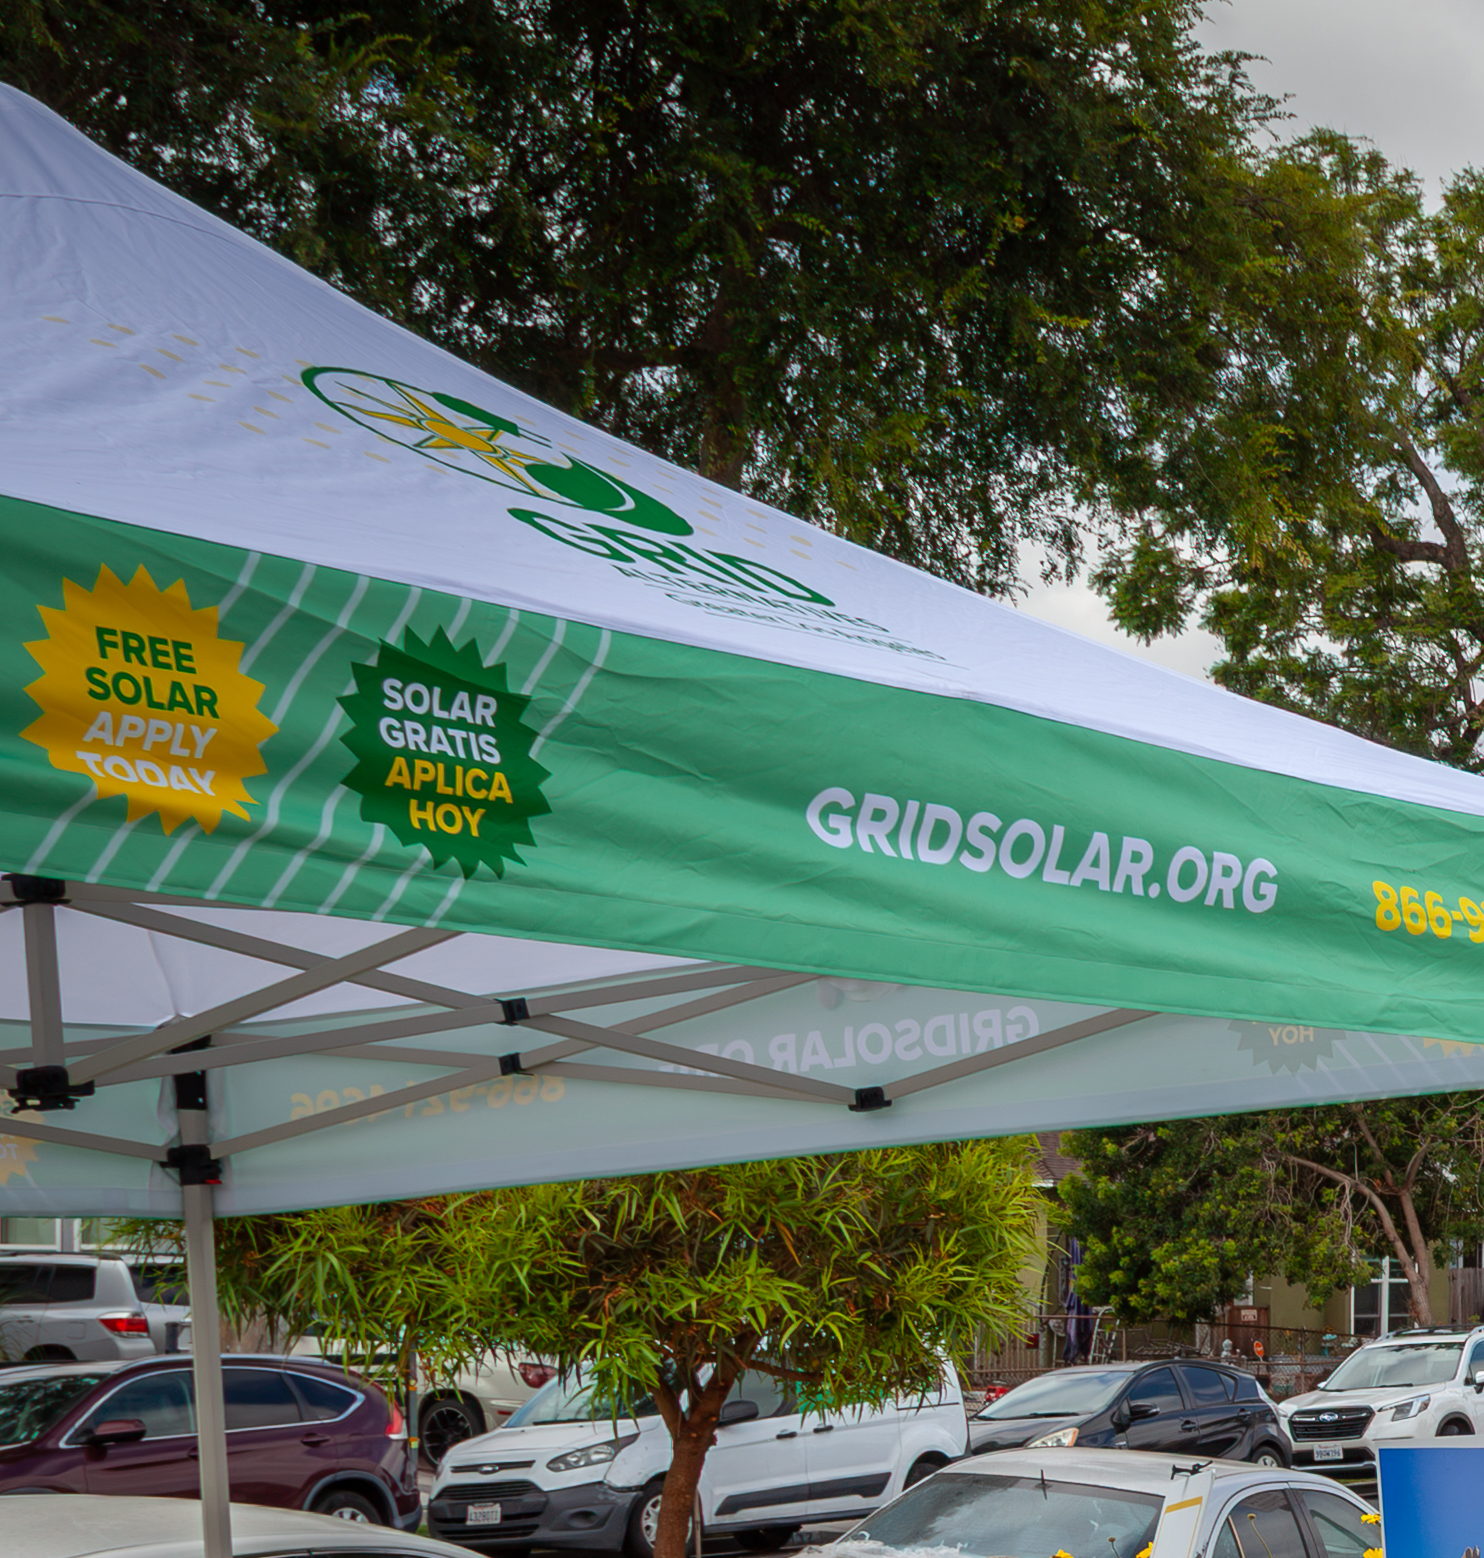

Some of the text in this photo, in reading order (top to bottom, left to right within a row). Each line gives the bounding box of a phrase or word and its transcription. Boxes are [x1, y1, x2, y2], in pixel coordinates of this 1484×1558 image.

[507, 506, 836, 607] GRID
[610, 563, 891, 633] ALTERNATIVES
[93, 624, 198, 676] FREE
[85, 666, 220, 720] SOLAR
[382, 676, 498, 728] SOLAR
[82, 709, 218, 760] APPLY
[378, 716, 501, 765] GRATIS
[75, 749, 217, 797] TODAY
[384, 755, 514, 805] APLICA
[408, 796, 487, 838] HOY
[806, 786, 1279, 915] GRIDSOLAR.ORG
